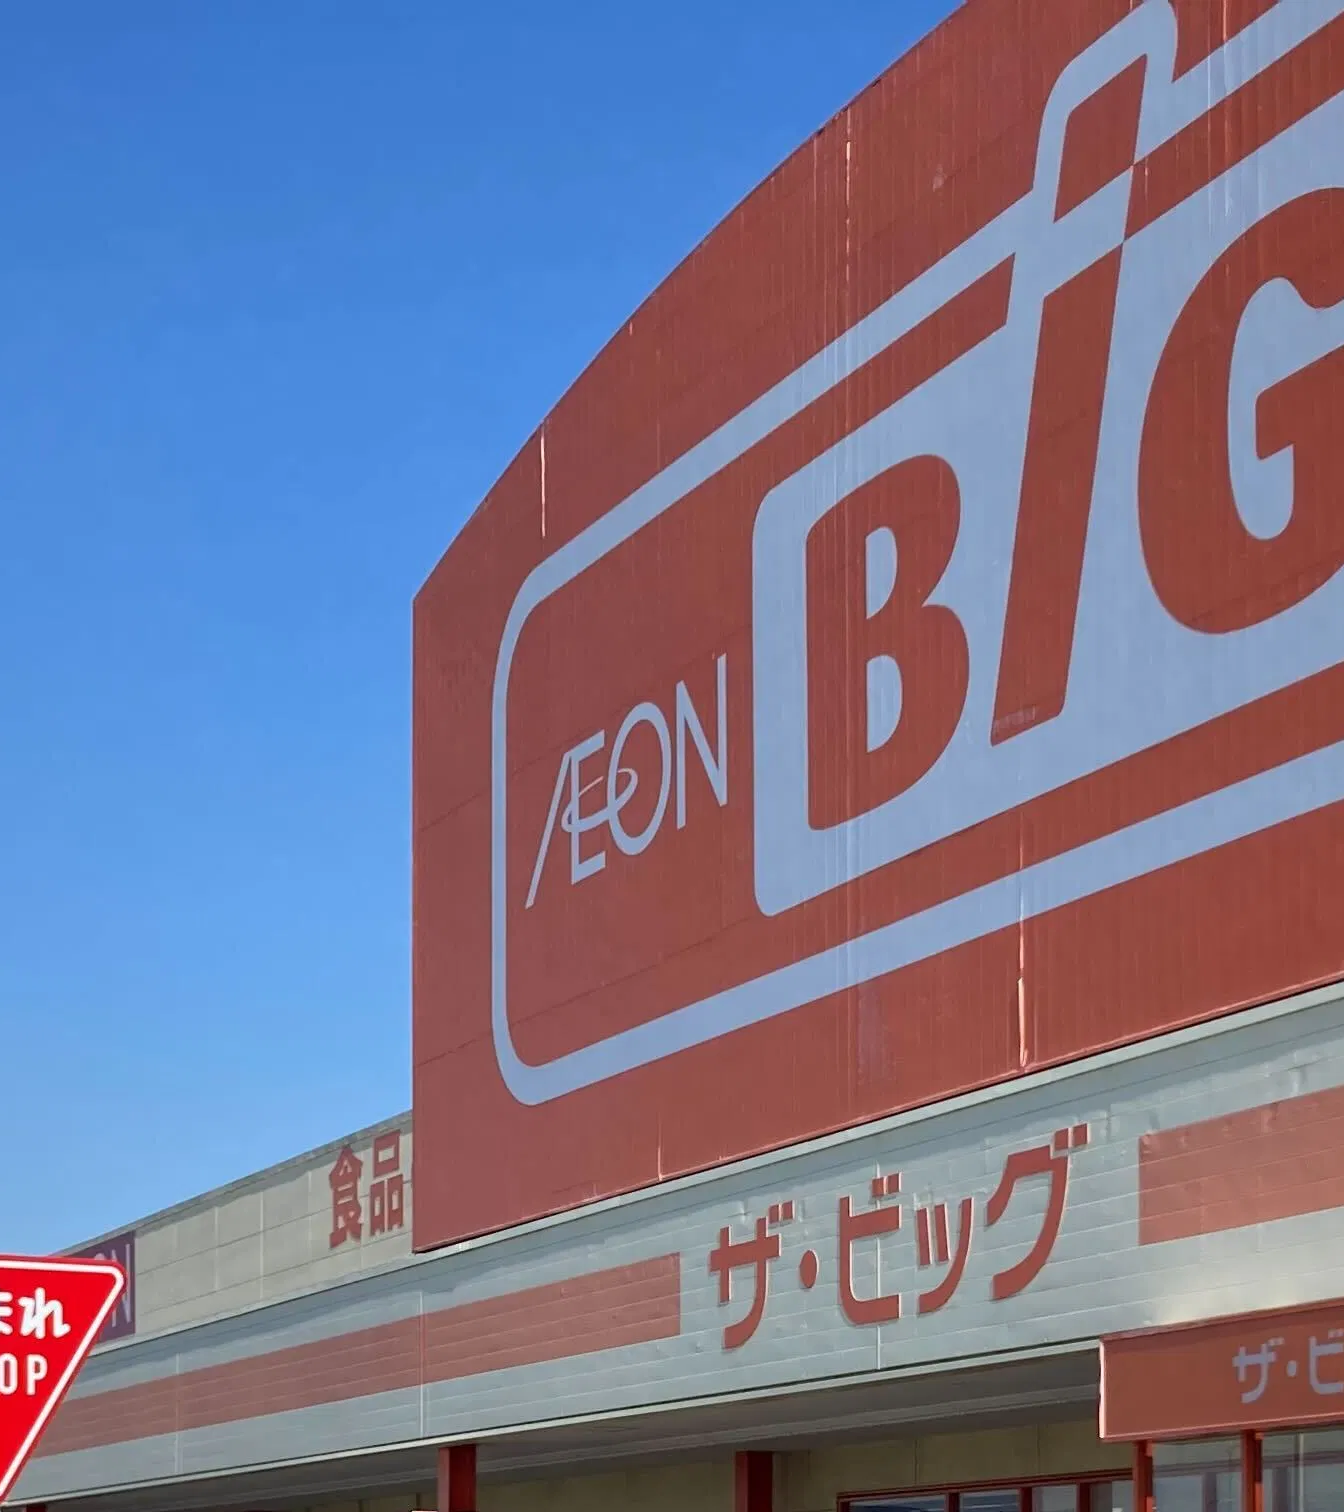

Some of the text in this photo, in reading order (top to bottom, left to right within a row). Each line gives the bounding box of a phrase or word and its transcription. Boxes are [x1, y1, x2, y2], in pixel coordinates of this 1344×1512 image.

[329, 1130, 404, 1249] 食品
[709, 1122, 1090, 1351] ザ・ビッグ
